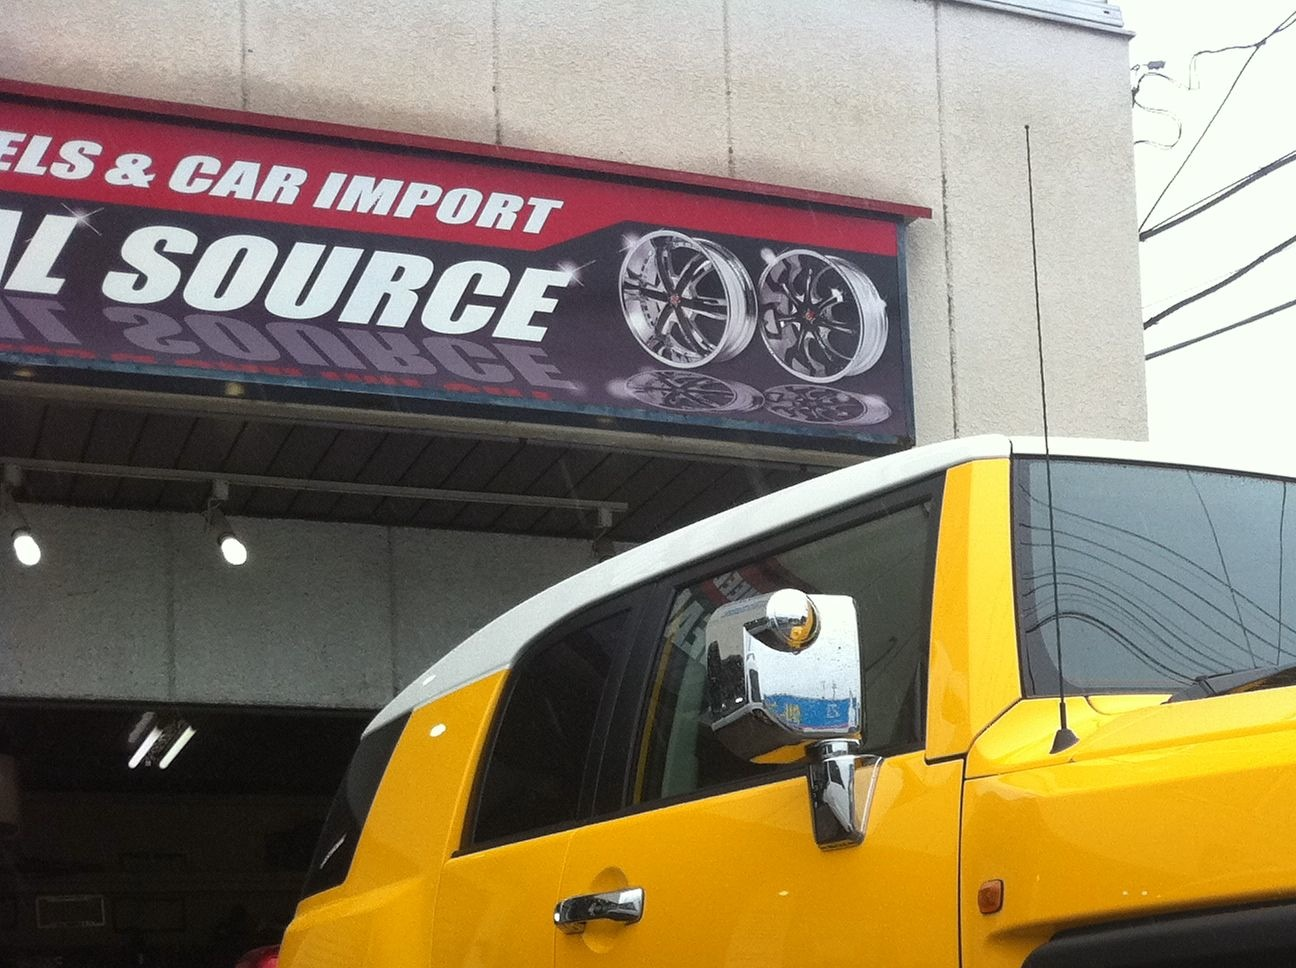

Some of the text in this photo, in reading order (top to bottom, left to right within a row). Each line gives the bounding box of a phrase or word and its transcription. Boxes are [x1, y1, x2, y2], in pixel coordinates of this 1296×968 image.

[104, 153, 155, 188] &
[168, 155, 308, 205] CAR
[312, 172, 564, 234] IMPORT
[0, 209, 576, 342] L SOURCE
